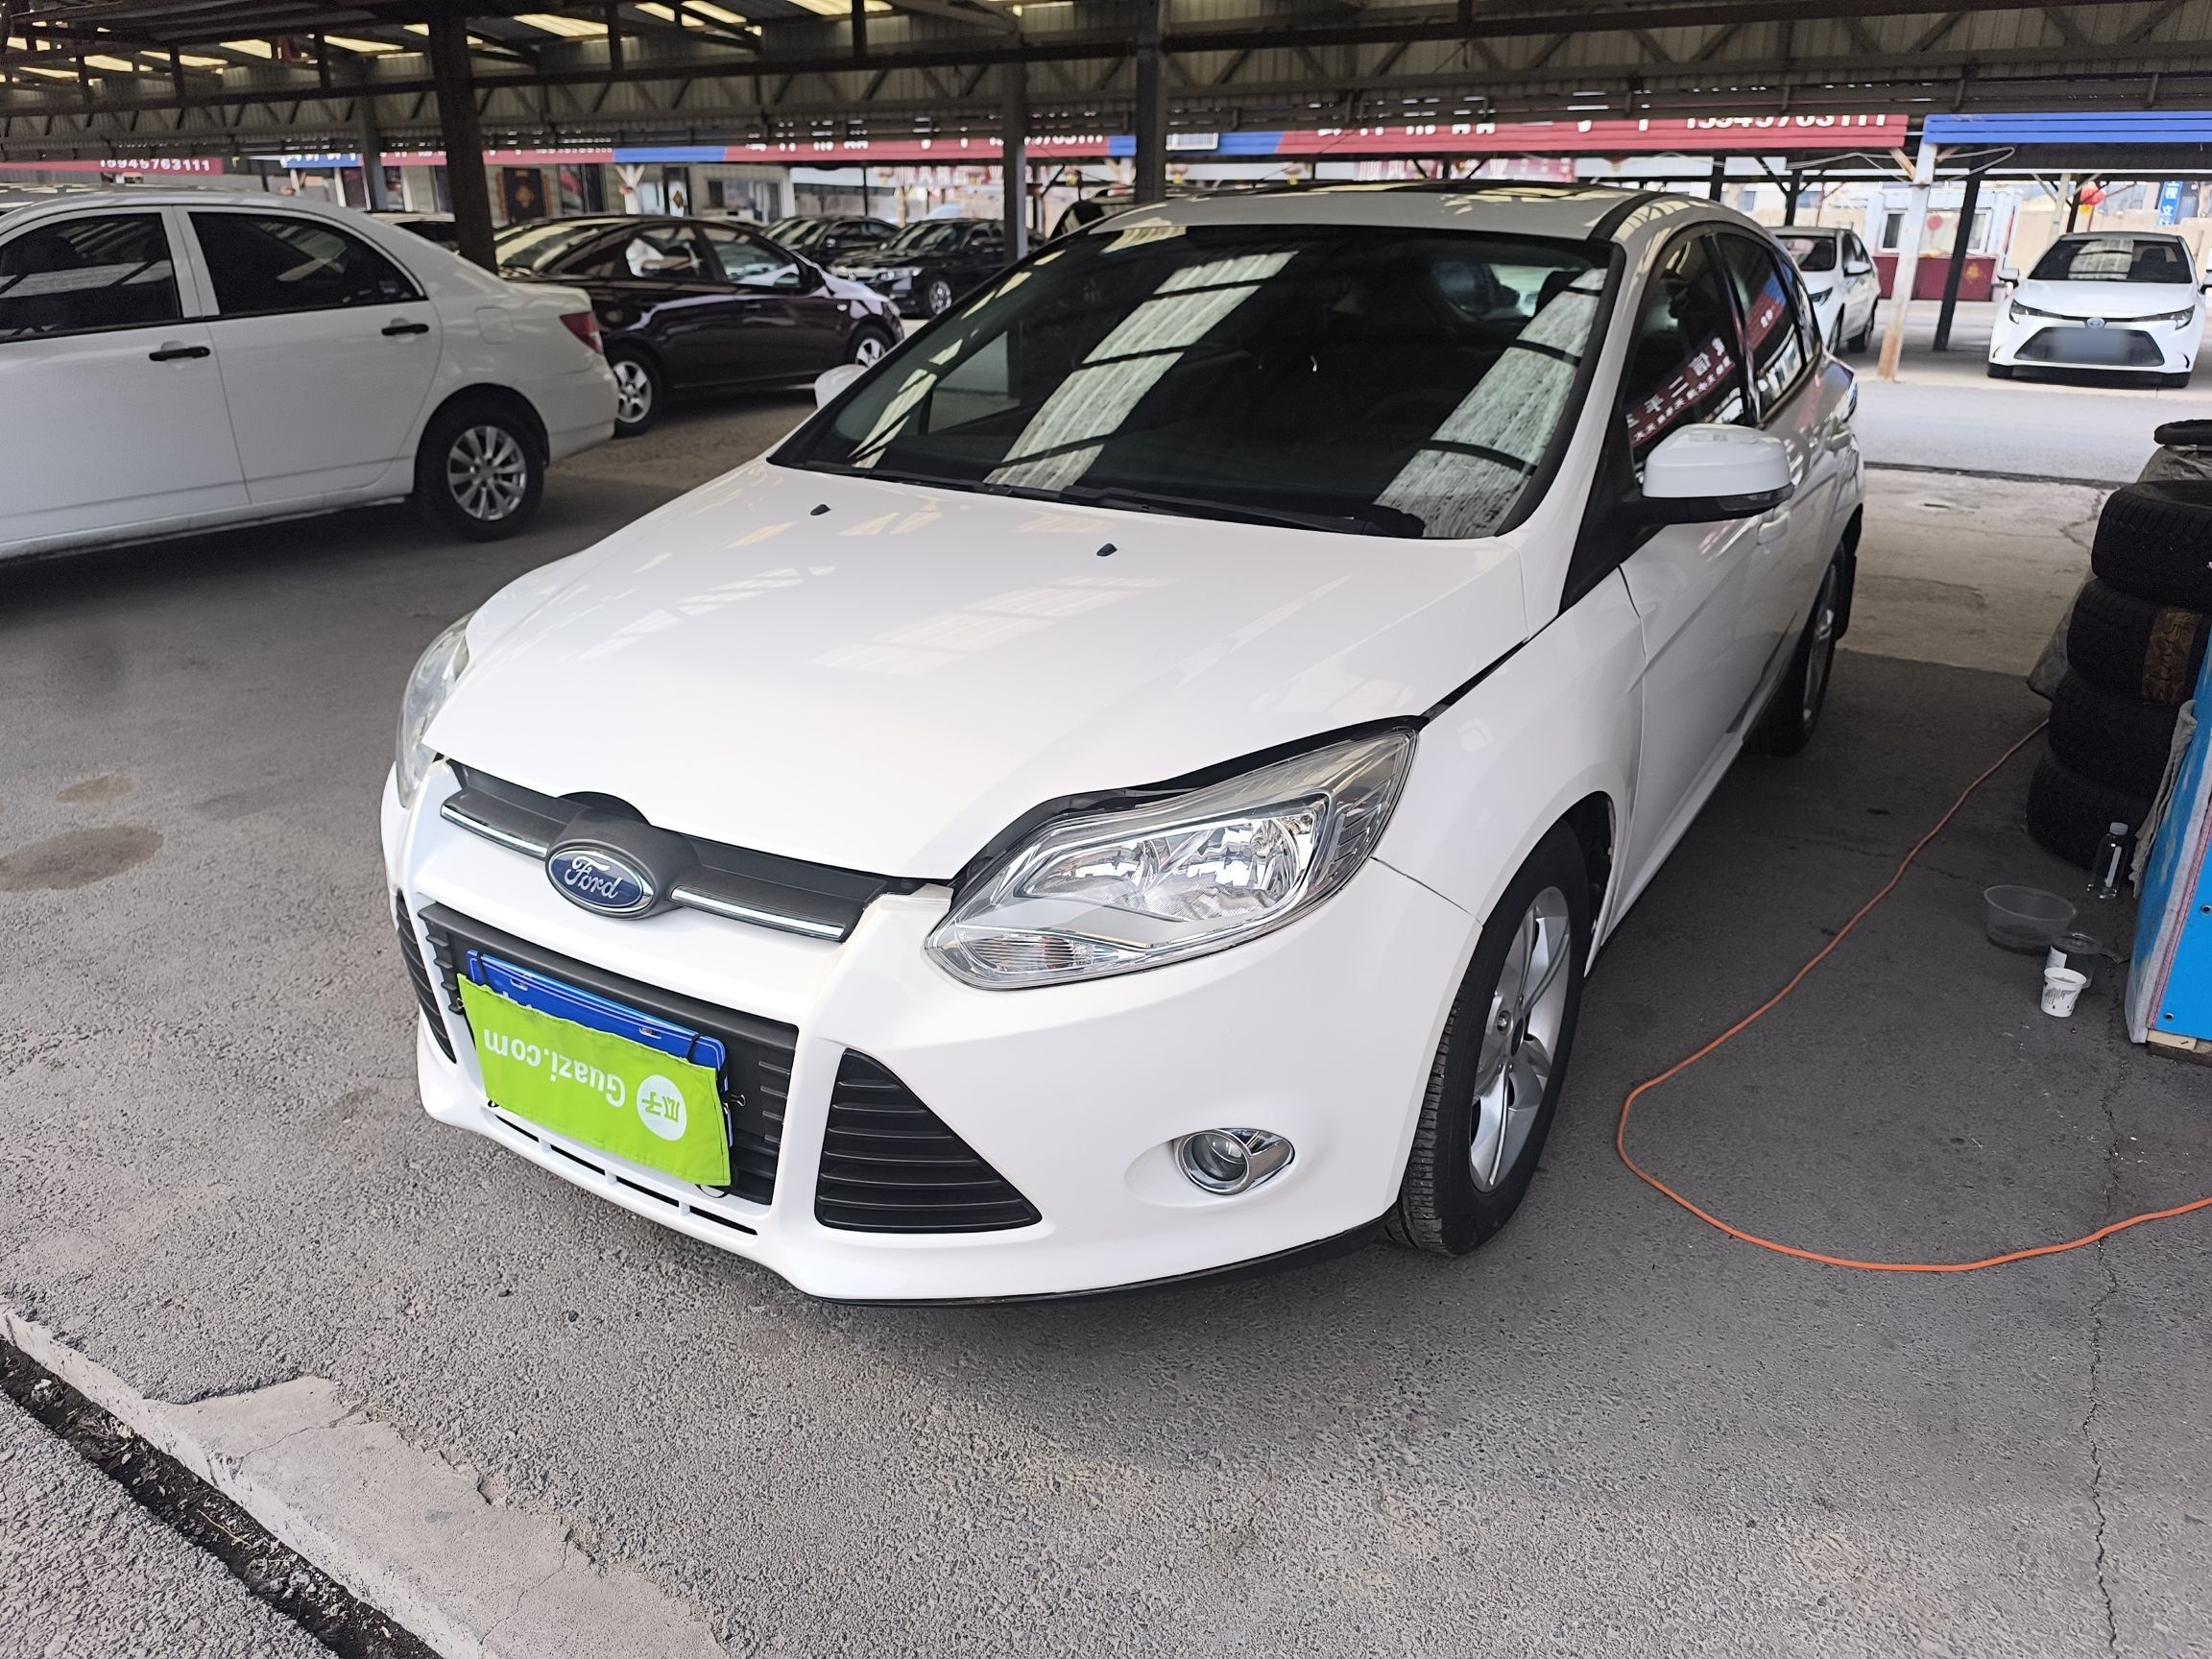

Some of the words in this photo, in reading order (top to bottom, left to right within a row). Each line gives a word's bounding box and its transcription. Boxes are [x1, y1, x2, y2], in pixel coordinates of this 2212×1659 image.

[564, 855, 623, 900] Ford
[484, 1028, 626, 1108] Guazi.com
[640, 1090, 680, 1124] 瓜子
